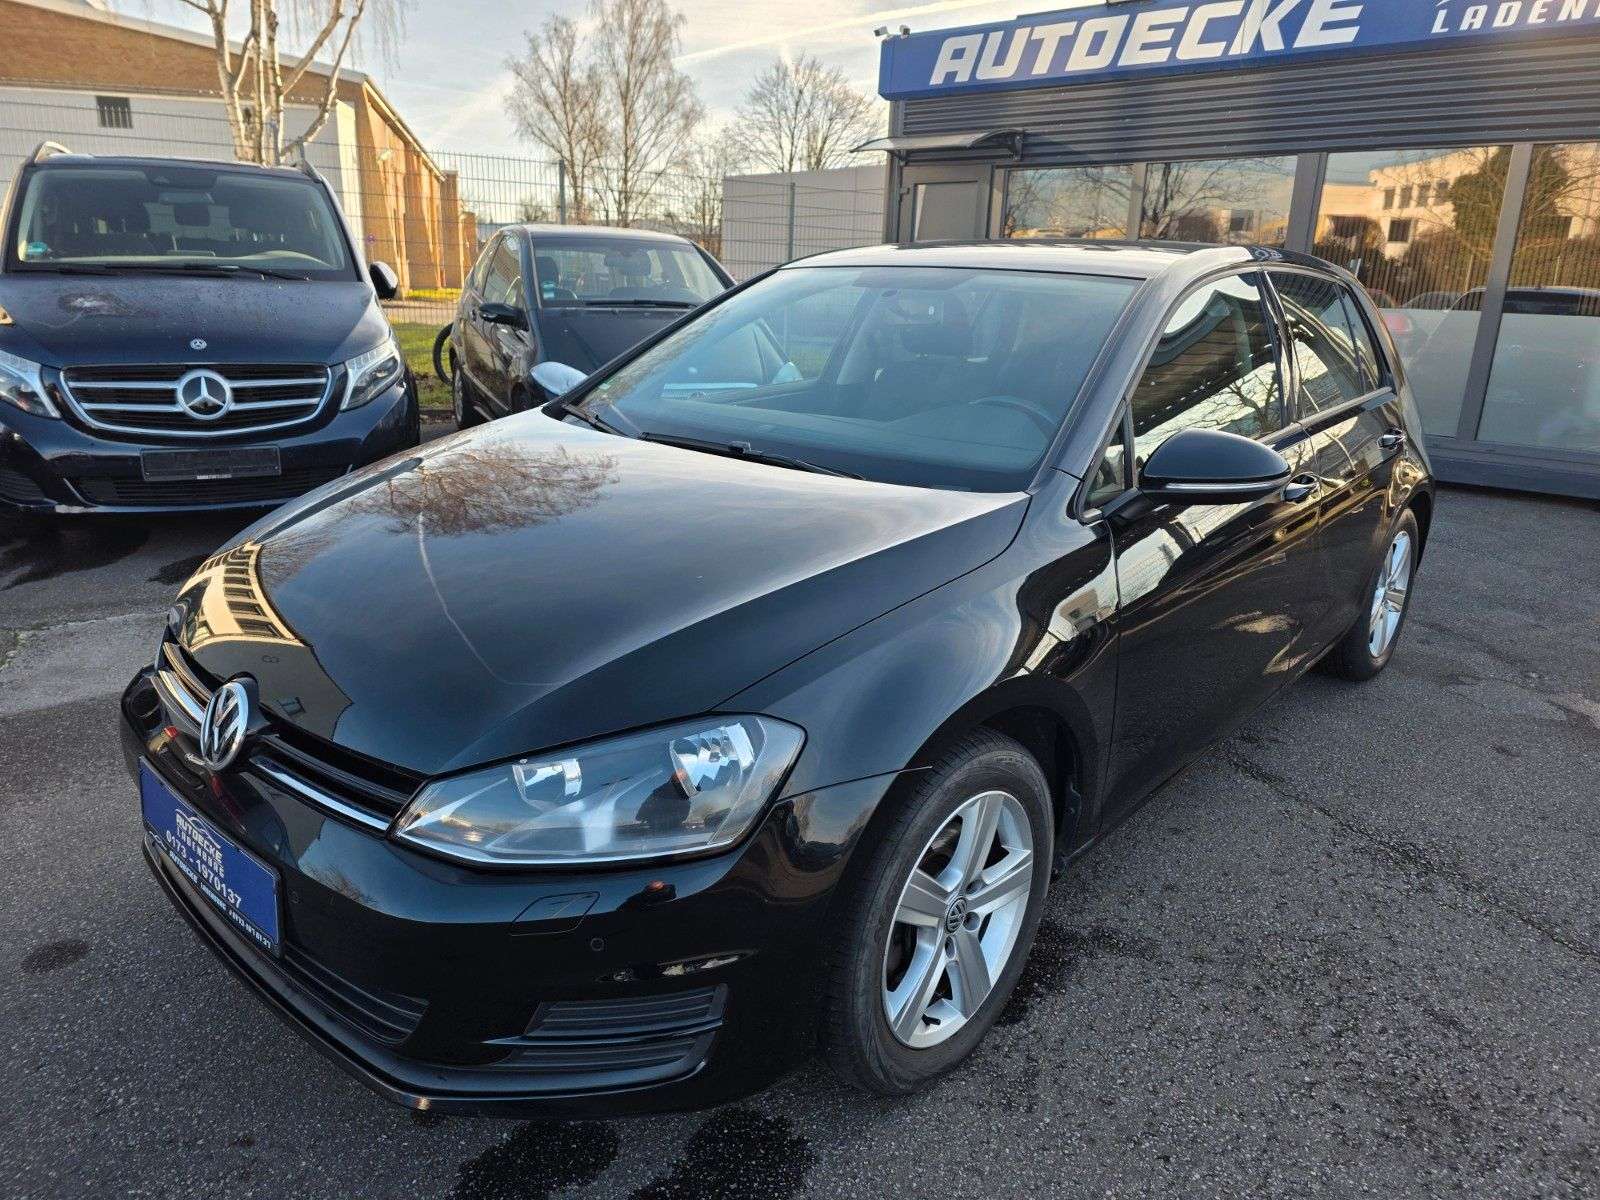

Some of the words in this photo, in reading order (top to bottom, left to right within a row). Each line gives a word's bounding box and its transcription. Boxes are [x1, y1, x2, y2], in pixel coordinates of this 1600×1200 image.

[929, 0, 1362, 85] AUTOECKE
[1431, 0, 1600, 33] LADEN
[166, 830, 187, 859] 0173
[196, 859, 241, 908] 1970137
[176, 813, 222, 863] AUTOECKE
